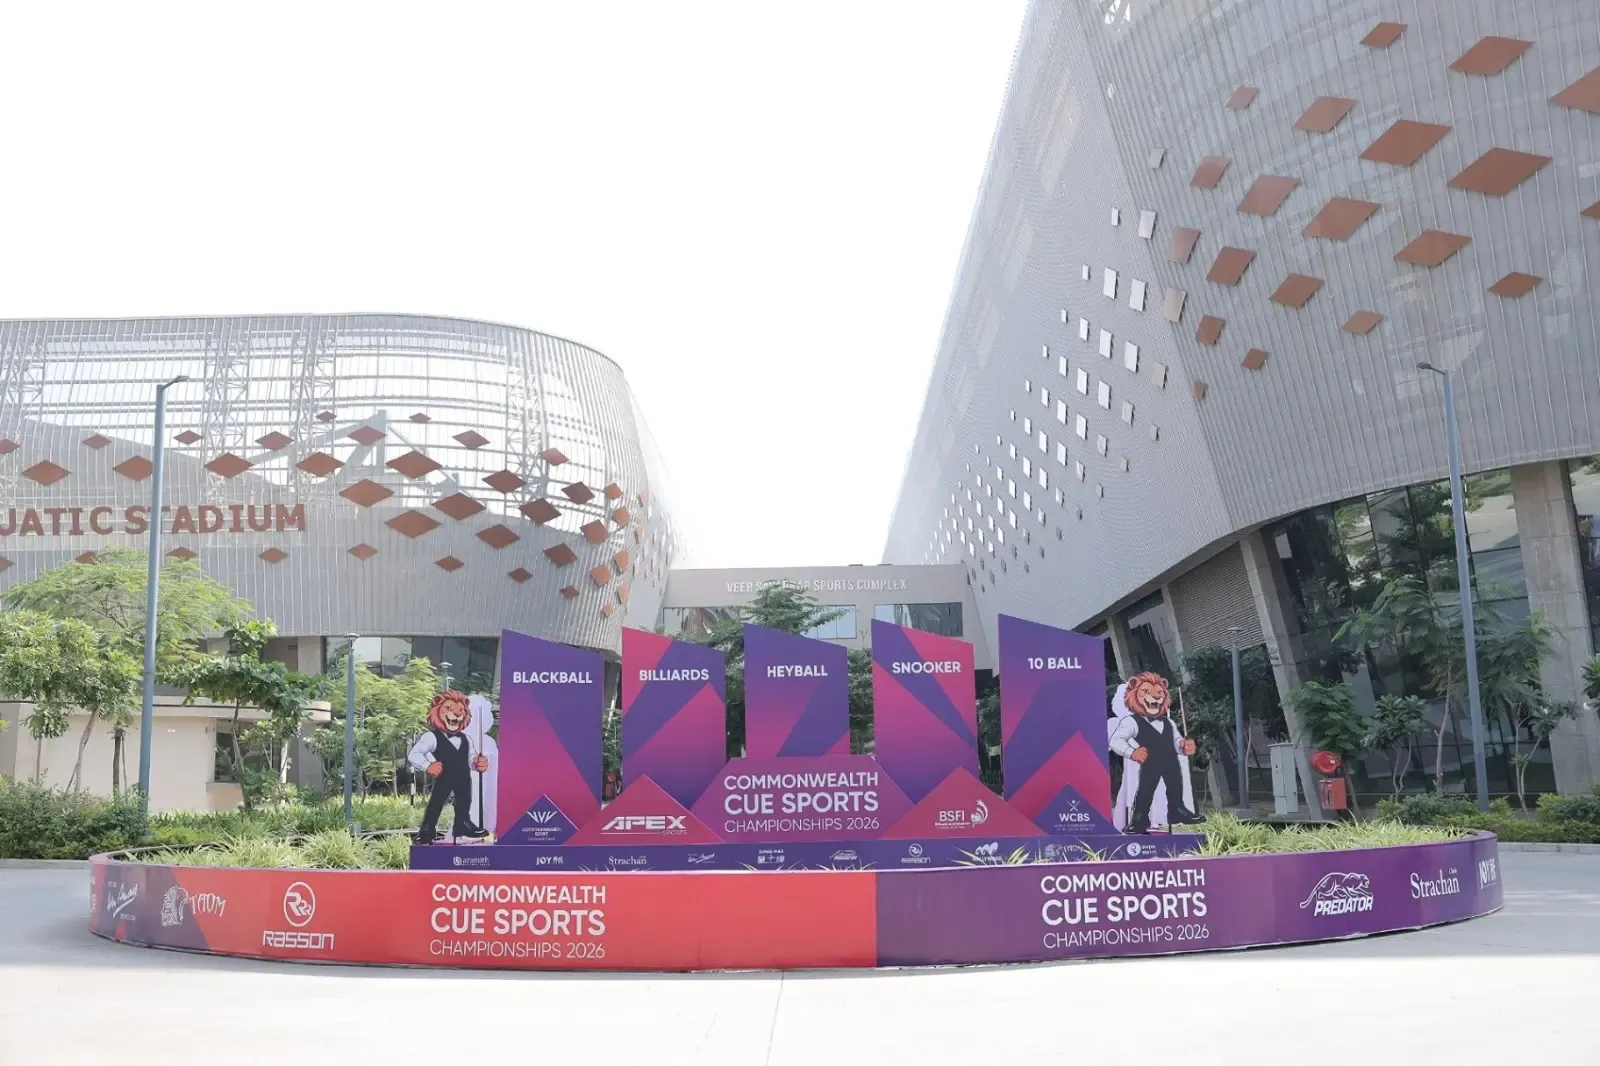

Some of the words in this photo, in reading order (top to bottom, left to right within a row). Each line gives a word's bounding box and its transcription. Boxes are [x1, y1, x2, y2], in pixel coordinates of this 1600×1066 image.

[726, 581, 753, 593] VEER
[813, 580, 854, 591] SPORTS
[857, 579, 907, 590] COMPLEX
[766, 664, 829, 678] HEYBALL
[892, 661, 962, 675] SNOOKER
[1027, 657, 1044, 670] 10
[1047, 656, 1082, 670] BALL
[512, 671, 593, 685] BLACKBALL
[639, 668, 710, 682] BILLIARDS
[724, 771, 879, 790] COMMONWEALTH
[724, 793, 774, 815] CUE
[781, 791, 879, 814] SPORTS
[601, 815, 687, 831] APEX
[939, 810, 965, 821] BSFI
[1058, 812, 1091, 822] WCBS
[724, 817, 843, 833] CHAMPIONSHIPS
[846, 816, 880, 830] 2026
[536, 856, 551, 865] JOY
[608, 855, 647, 865] Strachan
[1040, 868, 1206, 894] COMMONWEALTH
[1410, 868, 1460, 899] Strachan
[431, 883, 607, 904] COMMONWEALTH
[1041, 897, 1099, 926] CUE
[1106, 891, 1208, 922] SPORTS
[1313, 895, 1374, 917] PREDATOR
[430, 906, 486, 934] CUE
[493, 908, 606, 936] SPORTS
[1043, 925, 1174, 949] CHAMPIONSHIPS
[1177, 923, 1210, 941] 2026
[430, 939, 562, 958] CHAMPIONSHIPS
[566, 942, 605, 959] 2026
